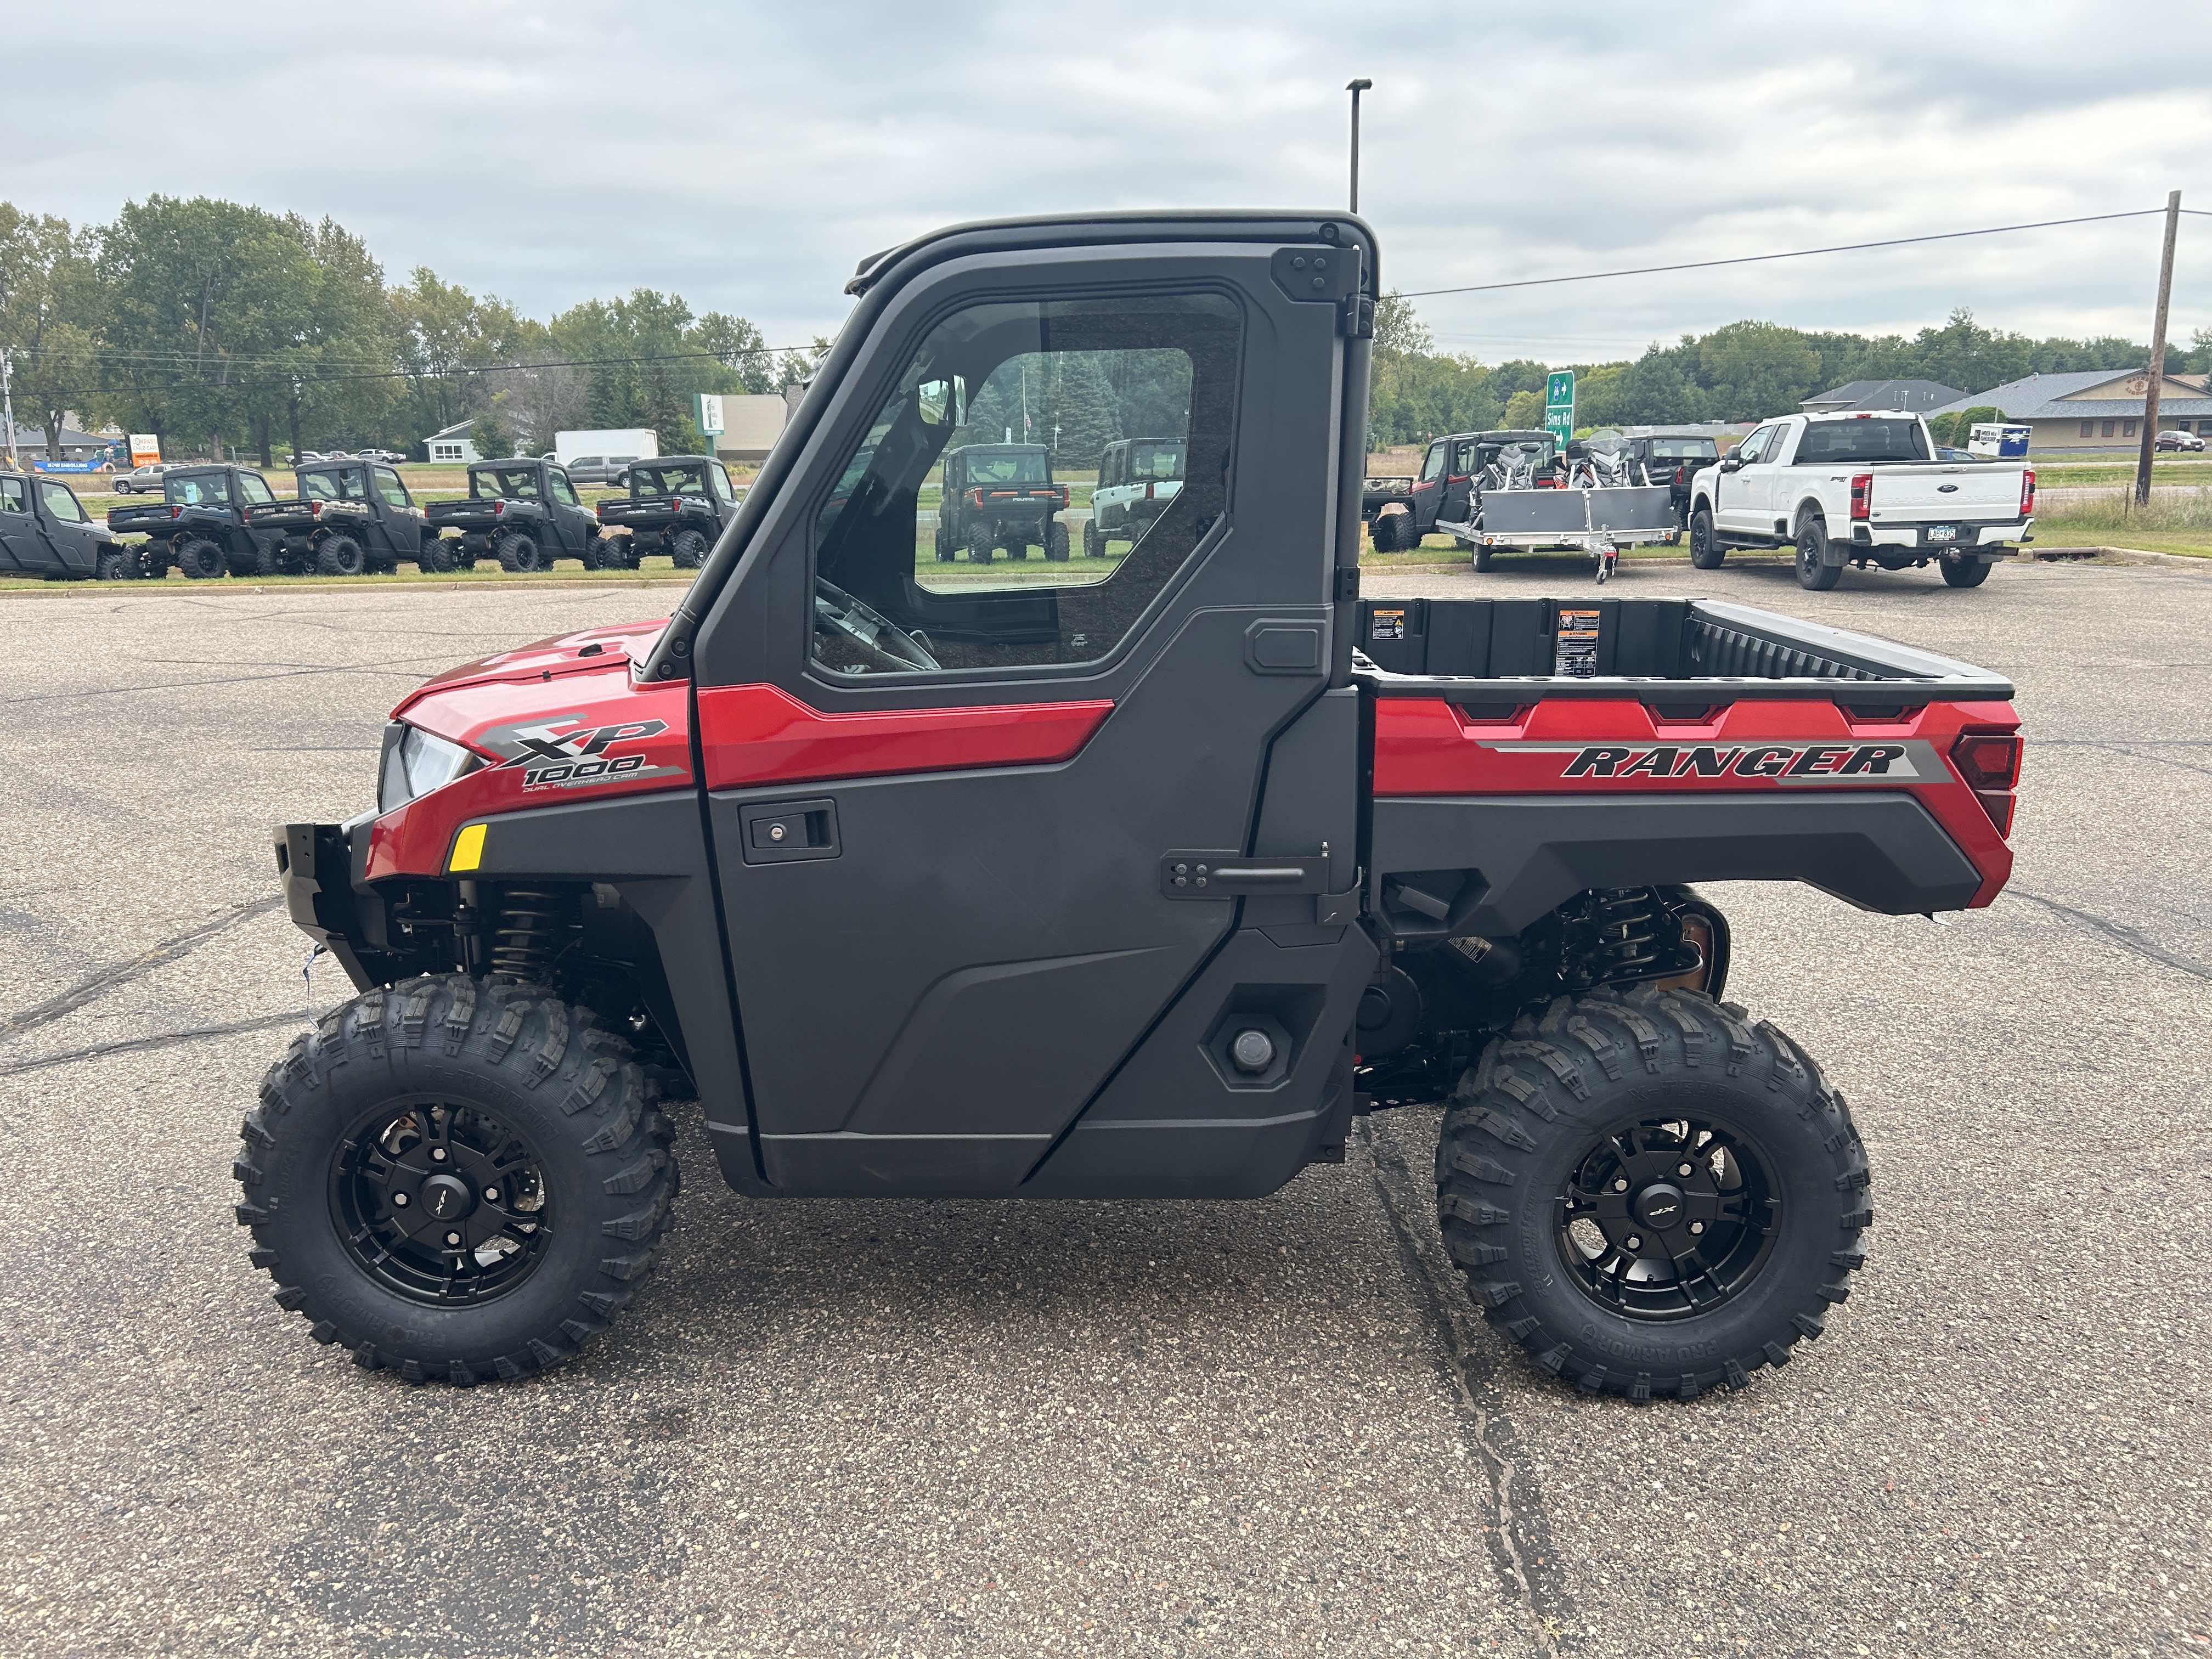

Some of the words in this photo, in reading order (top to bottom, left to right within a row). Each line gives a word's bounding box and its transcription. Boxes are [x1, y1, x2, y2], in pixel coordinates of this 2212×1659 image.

[1548, 413, 1561, 426] Sims
[1562, 412, 1571, 426] Rd
[1880, 495, 1954, 504] SUPER
[488, 719, 670, 771] XP
[522, 754, 646, 787] 1000
[1560, 744, 1908, 778] RANGER
[552, 776, 611, 788] OVERHEAD
[612, 772, 638, 781] CAM
[425, 1064, 560, 1142] X-TERRAIN
[1627, 1080, 1774, 1119] X-TERRAIN
[436, 1190, 447, 1216] XP
[1649, 1205, 1677, 1216] XP
[1596, 1335, 1671, 1363] ARMOR
[1677, 1339, 1720, 1362] PRO
